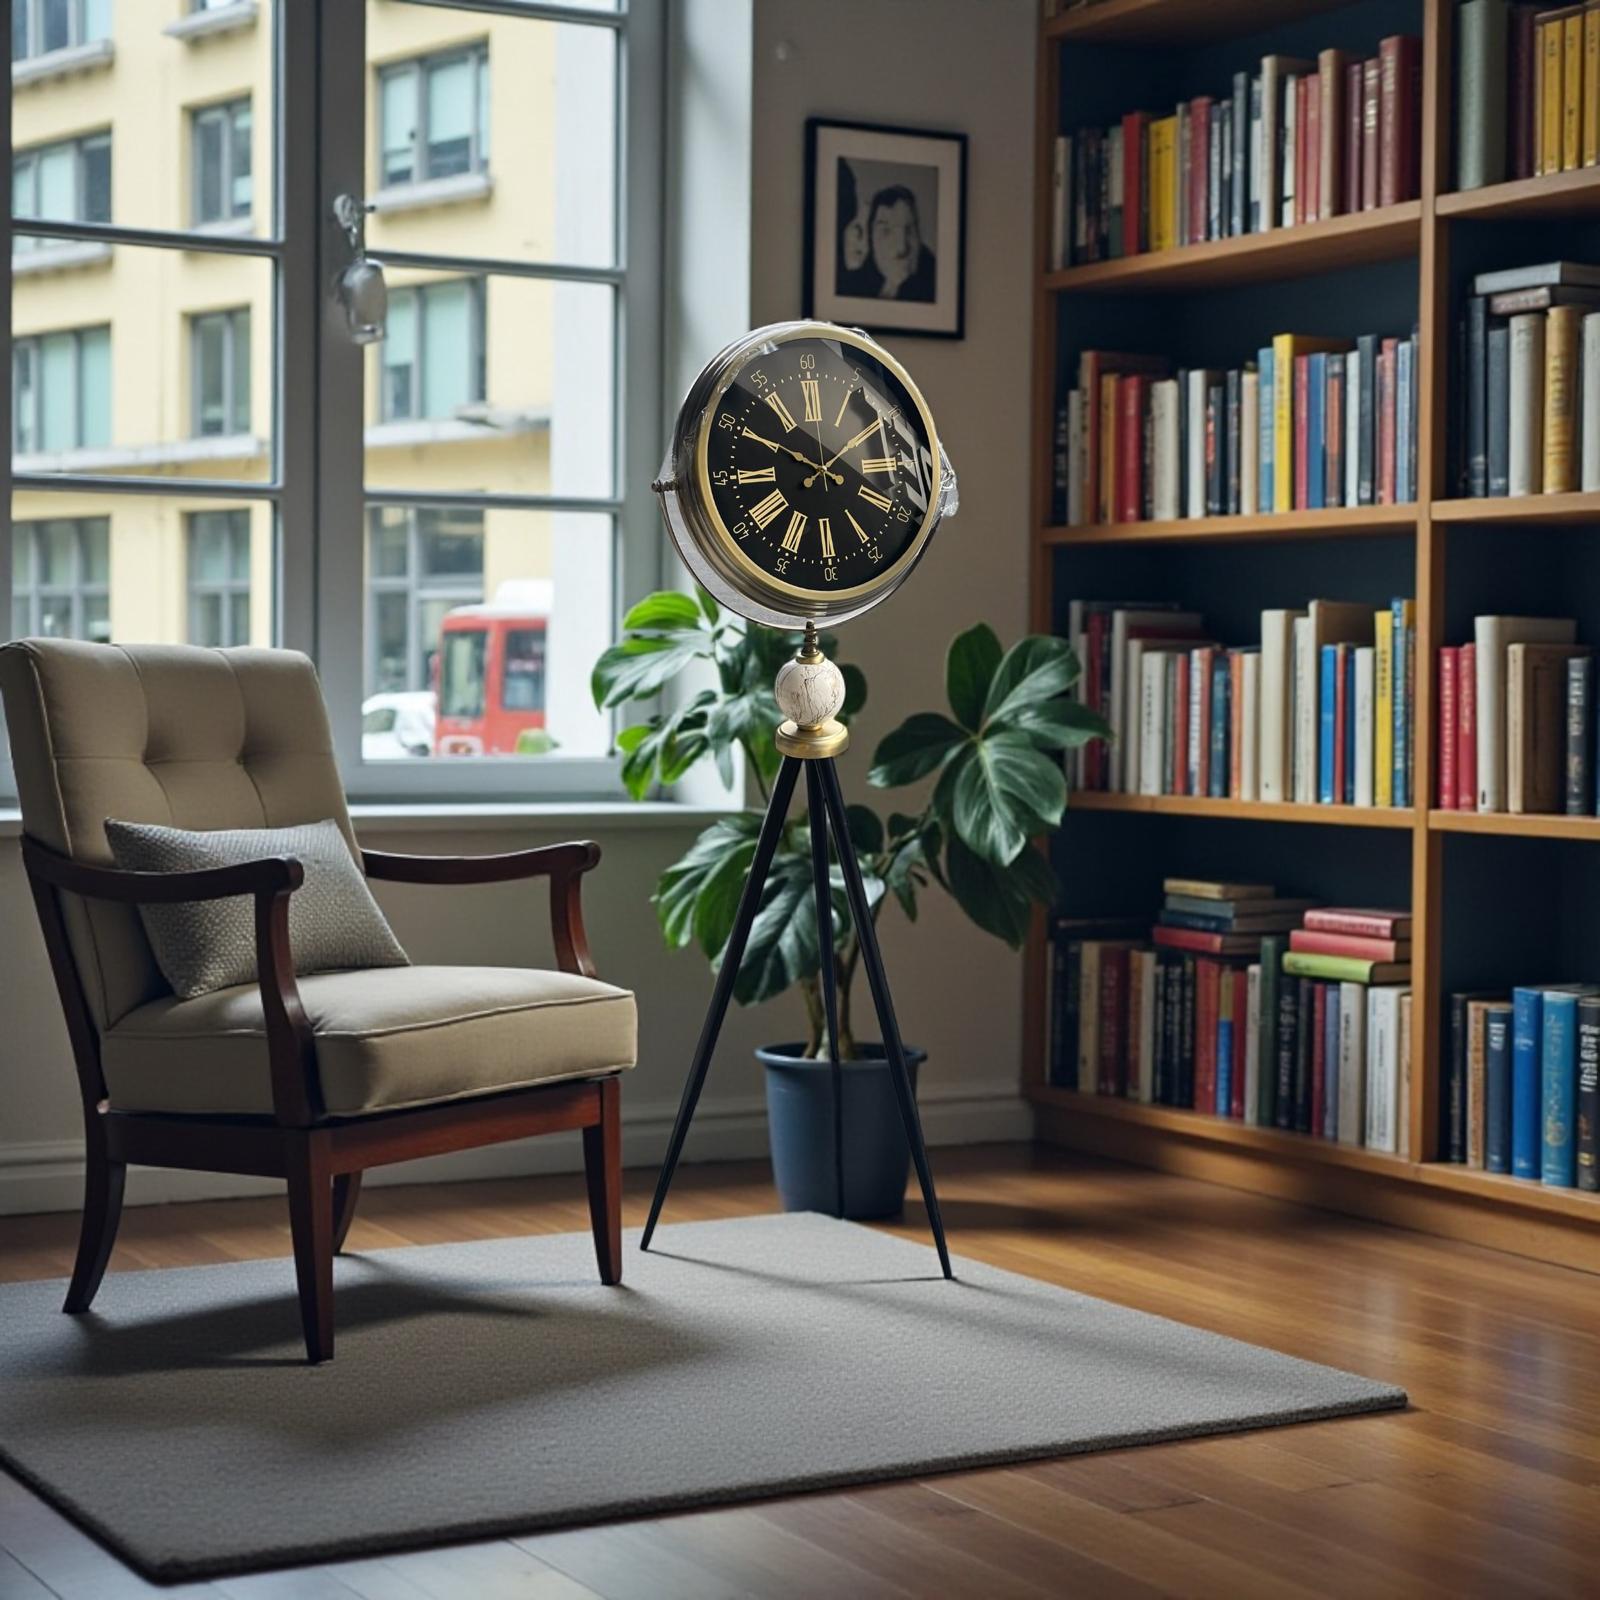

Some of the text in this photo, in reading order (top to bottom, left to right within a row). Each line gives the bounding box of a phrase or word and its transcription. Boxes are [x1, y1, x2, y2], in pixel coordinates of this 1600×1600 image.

[799, 354, 815, 370] 60
[750, 369, 768, 389] 55
[800, 379, 823, 422] XII
[765, 391, 797, 433] XI
[718, 413, 736, 432] 50
[741, 425, 780, 453] X
[737, 466, 777, 485] IX
[861, 456, 898, 477] III
[712, 470, 729, 486] 45
[896, 505, 912, 523] 20
[732, 522, 750, 540] 40
[844, 508, 870, 544] V
[867, 546, 883, 564] 25
[774, 557, 791, 575] 35
[824, 566, 838, 582] 30
